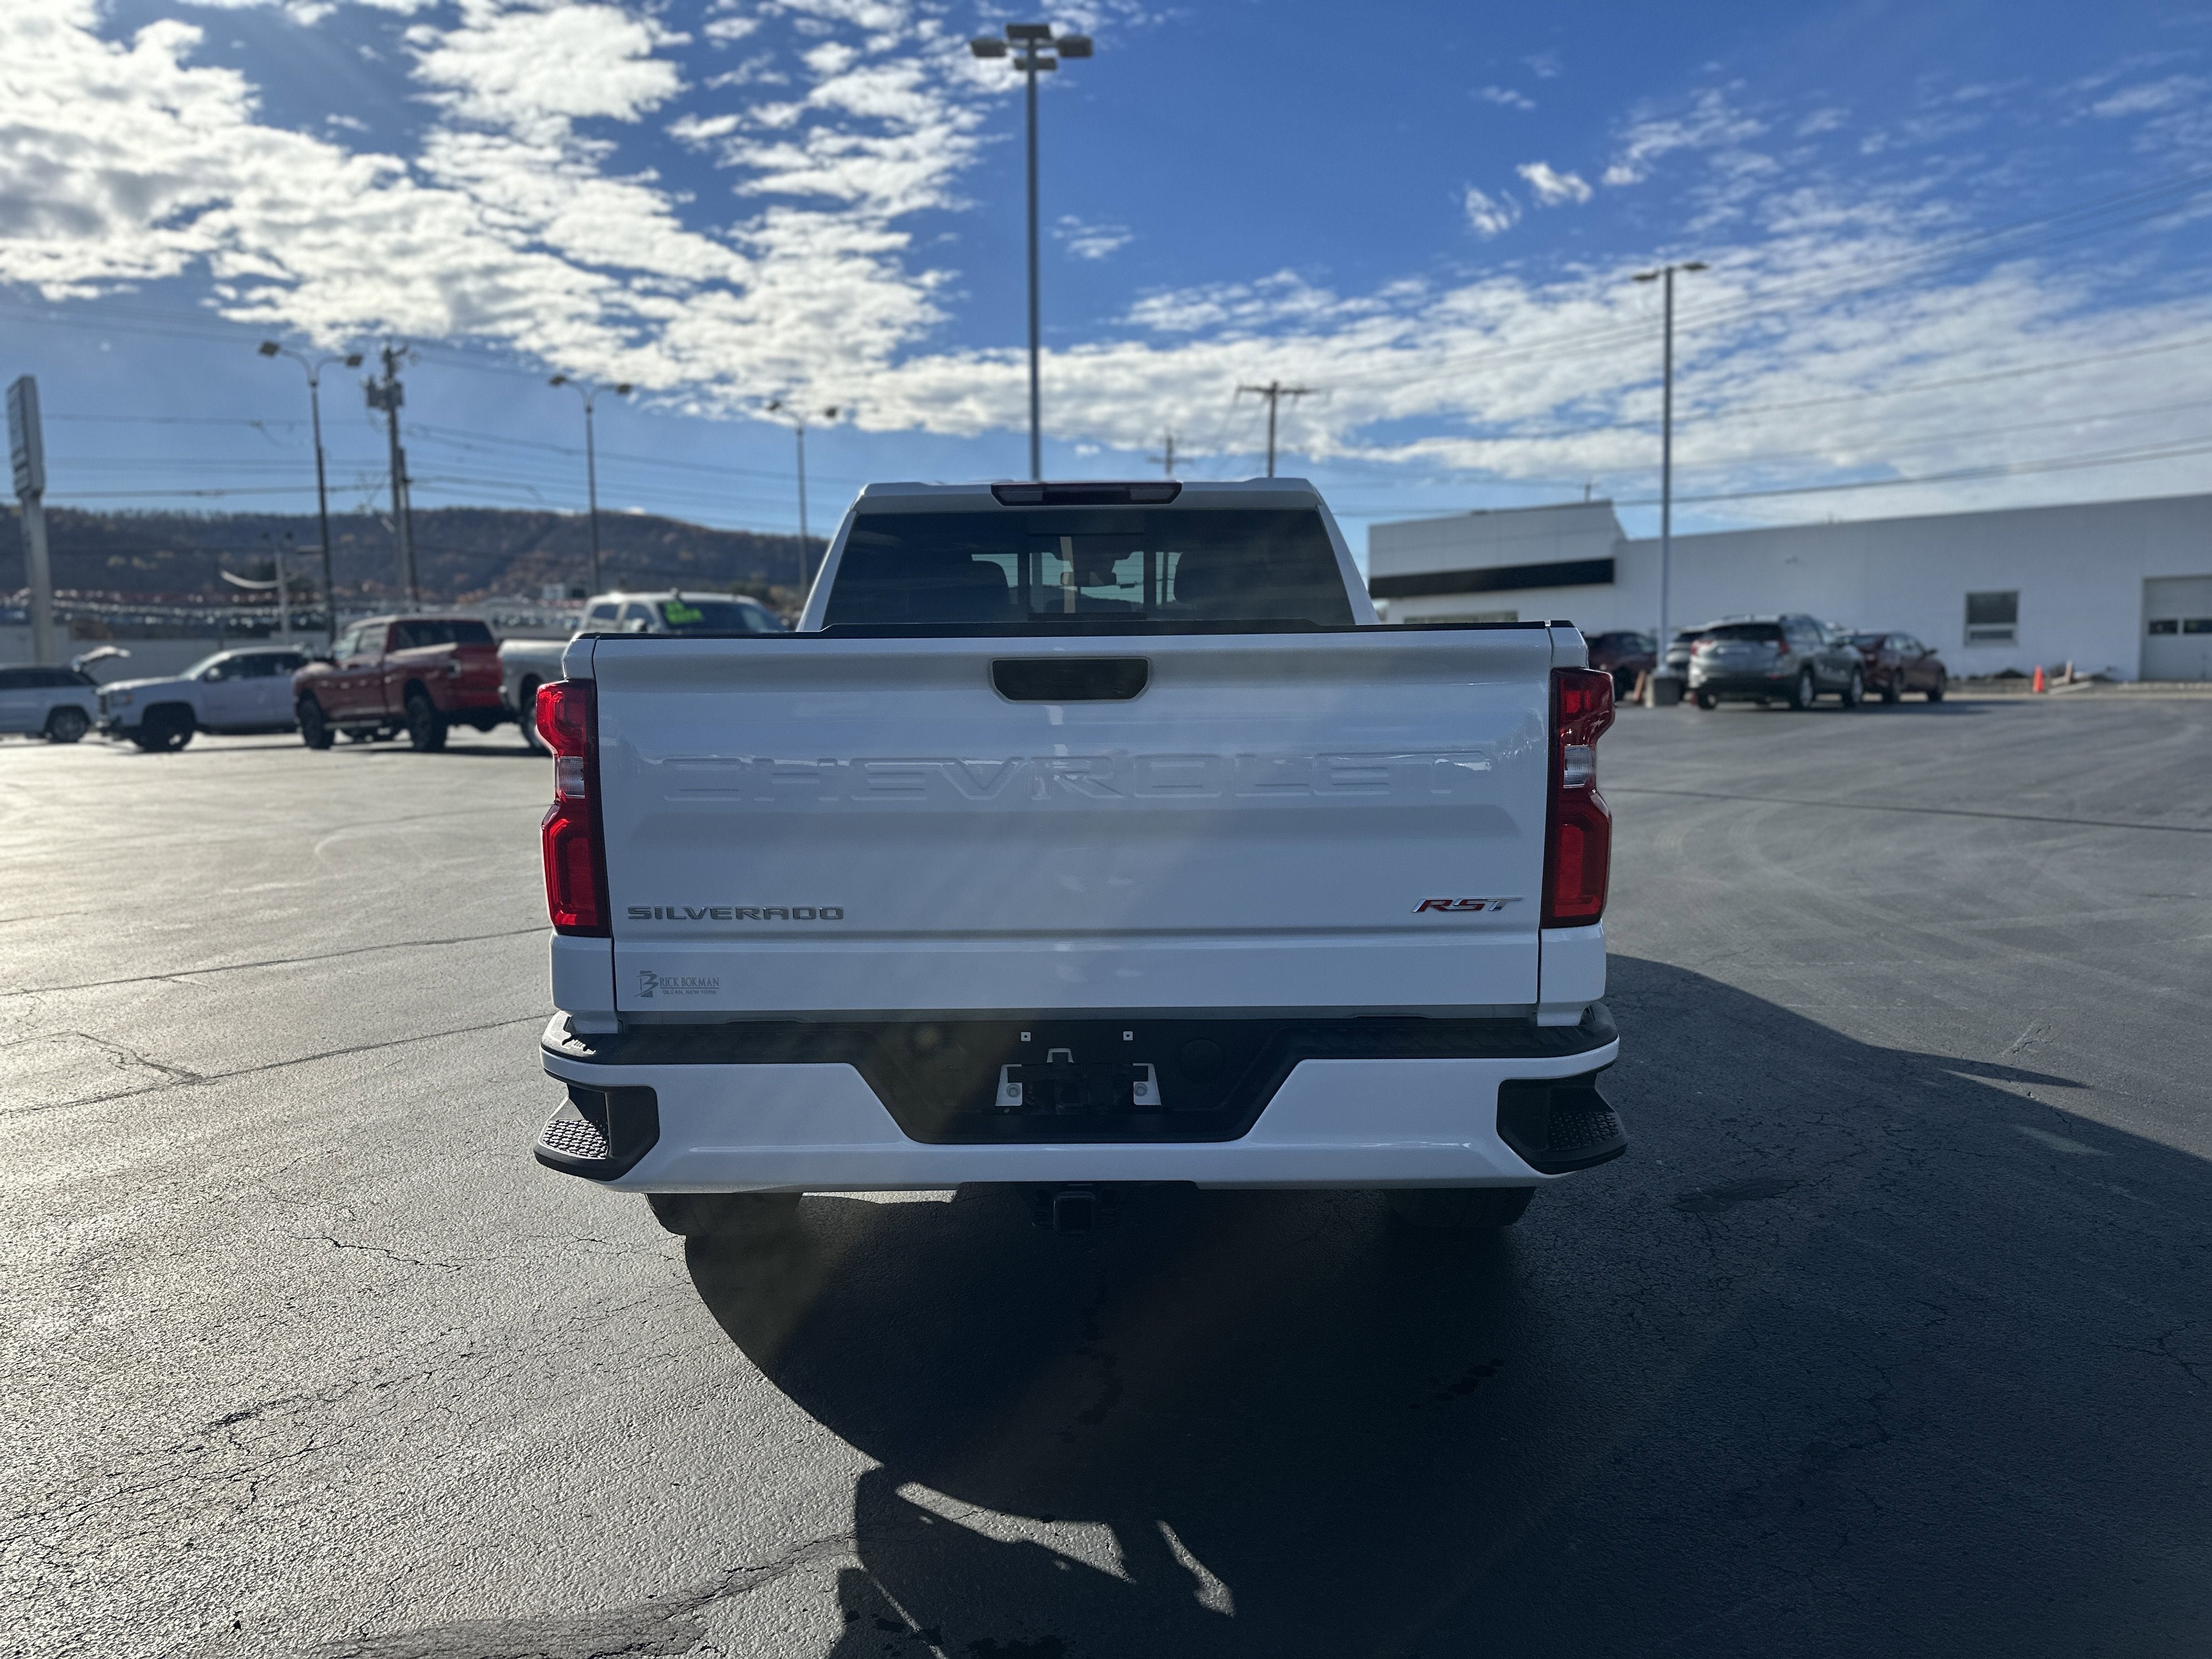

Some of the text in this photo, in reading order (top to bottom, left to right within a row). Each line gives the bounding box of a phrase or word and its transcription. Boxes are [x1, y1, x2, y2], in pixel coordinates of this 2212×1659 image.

[662, 750, 1486, 801] CHEVROLET
[1410, 897, 1524, 913] RST
[628, 906, 844, 920] SILVERADO
[659, 977, 720, 987] RICK BOKMAN
